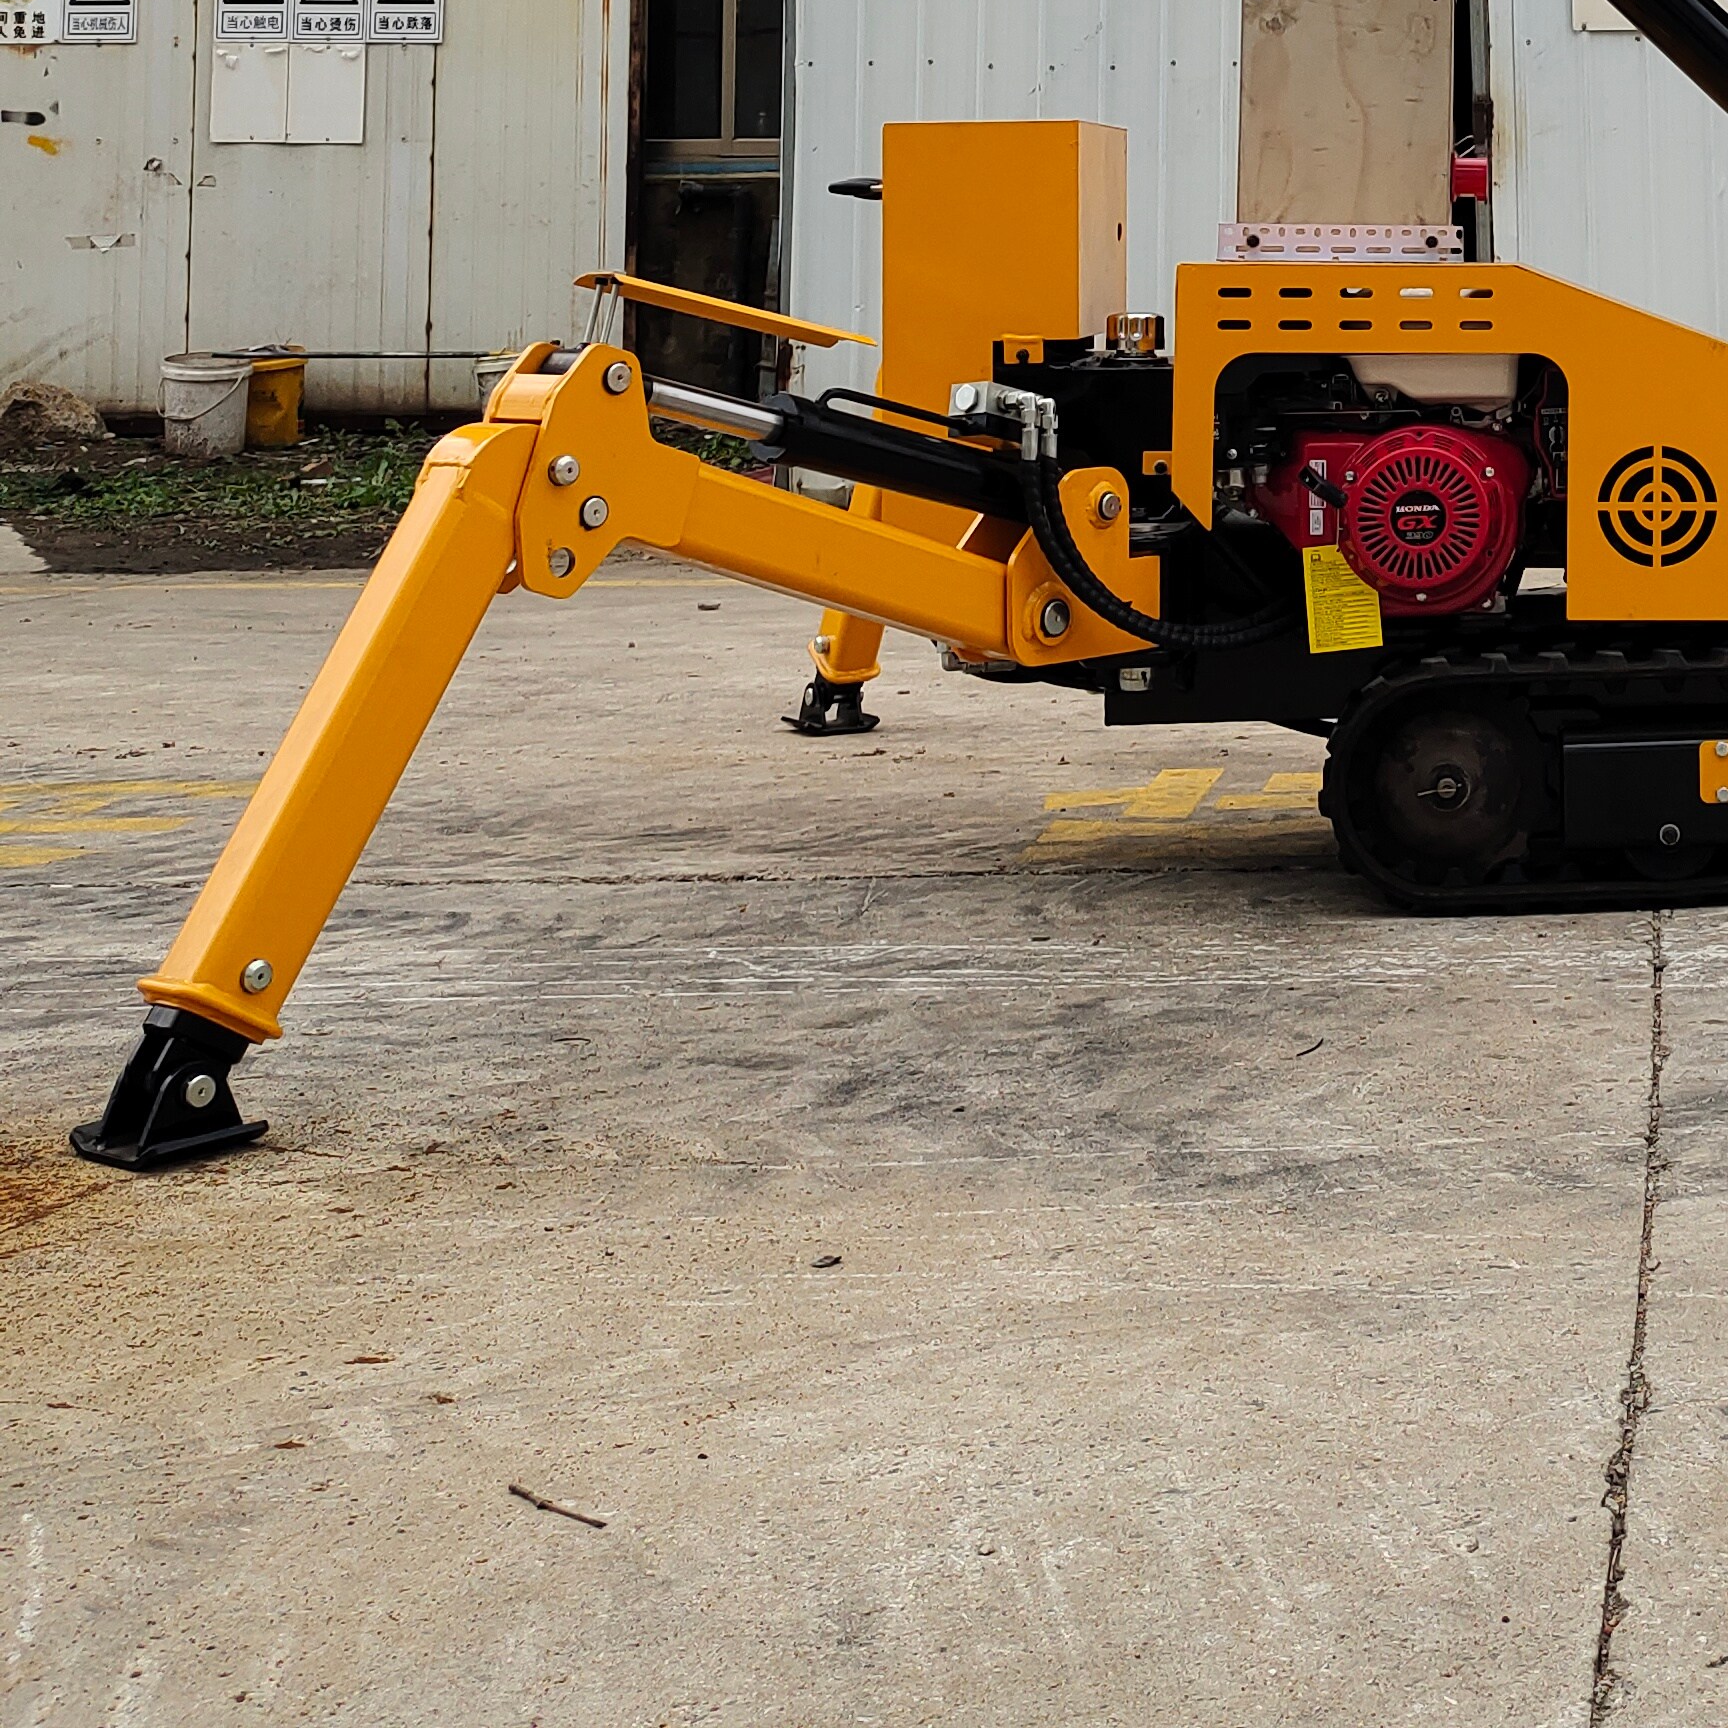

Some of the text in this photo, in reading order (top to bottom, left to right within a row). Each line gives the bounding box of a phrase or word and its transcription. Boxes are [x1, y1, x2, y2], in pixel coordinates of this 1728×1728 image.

[227, 15, 280, 30] 当心触电
[300, 16, 356, 32] 当心烫伤
[1396, 505, 1440, 513] HONDA
[1398, 515, 1438, 530] GX
